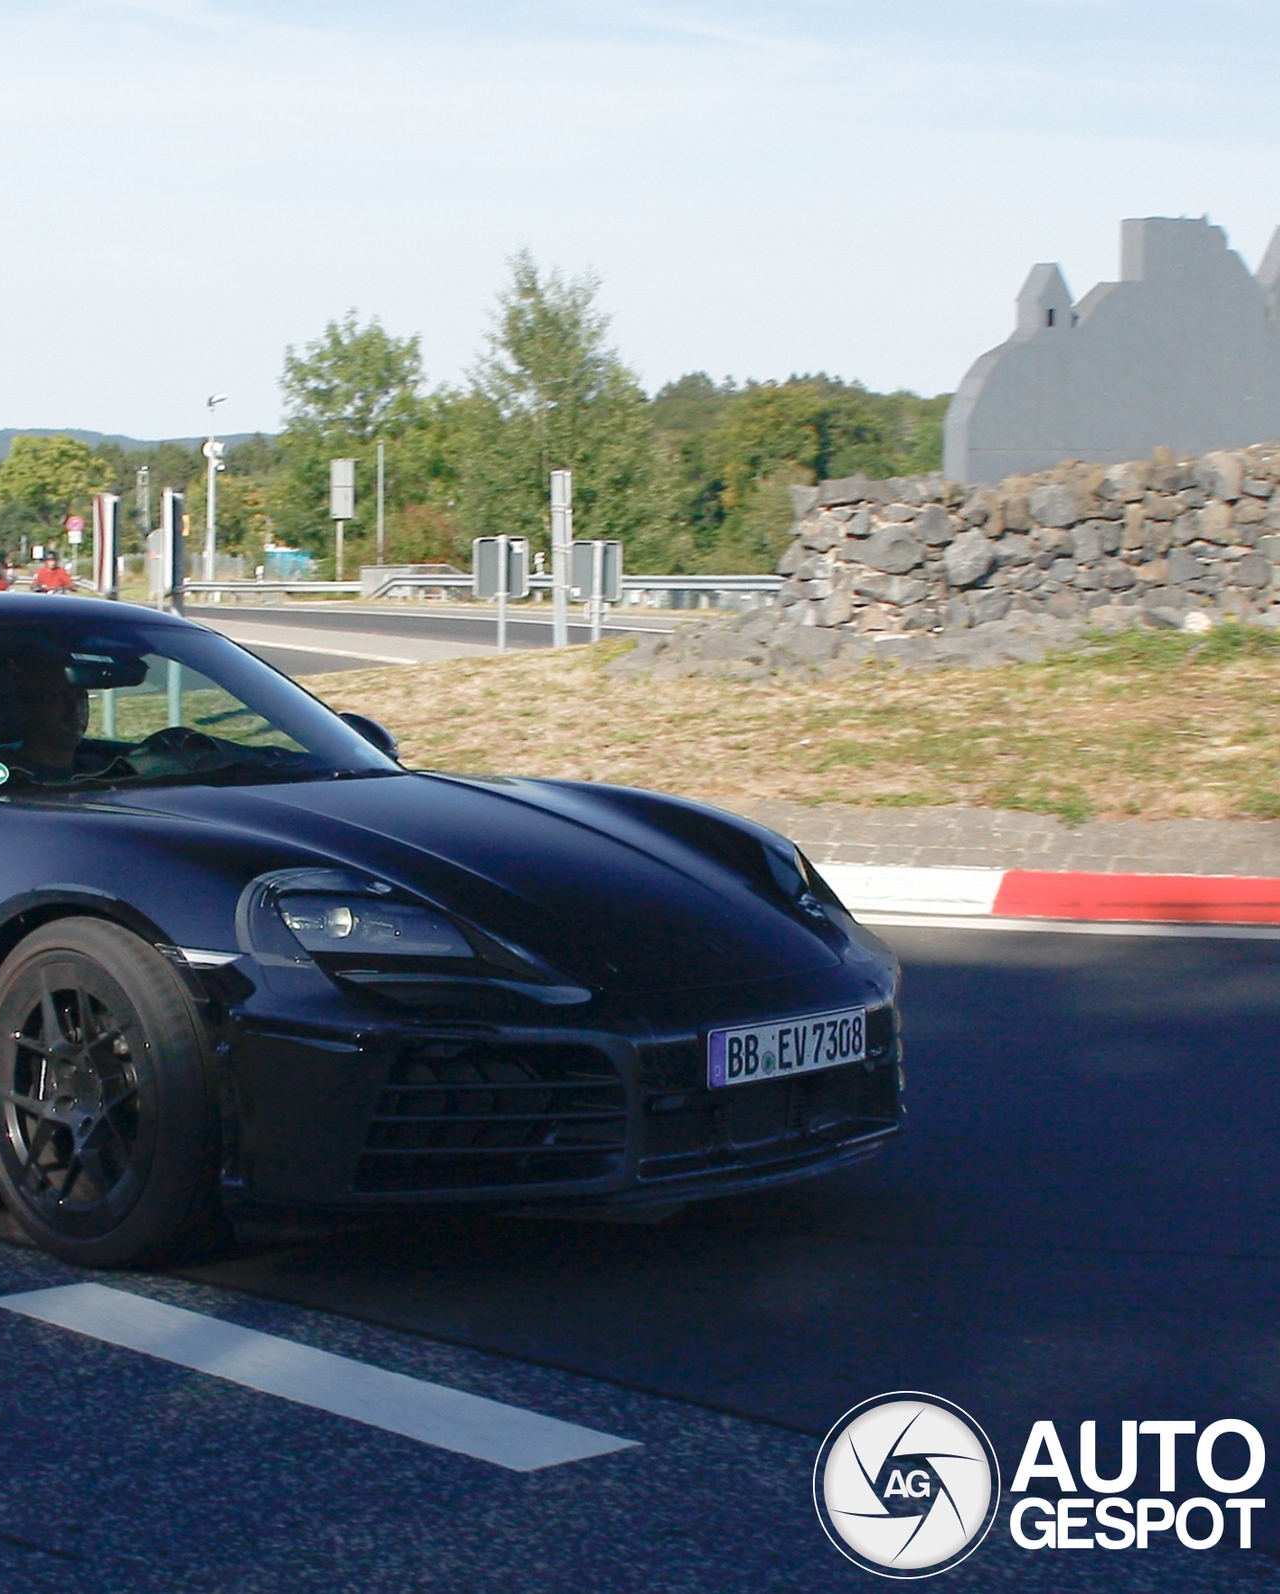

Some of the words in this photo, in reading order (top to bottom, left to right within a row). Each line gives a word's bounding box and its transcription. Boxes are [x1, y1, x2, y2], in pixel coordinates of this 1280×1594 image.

[728, 1034, 759, 1078] BB
[778, 1028, 807, 1070] EV
[812, 1016, 863, 1064] 7308
